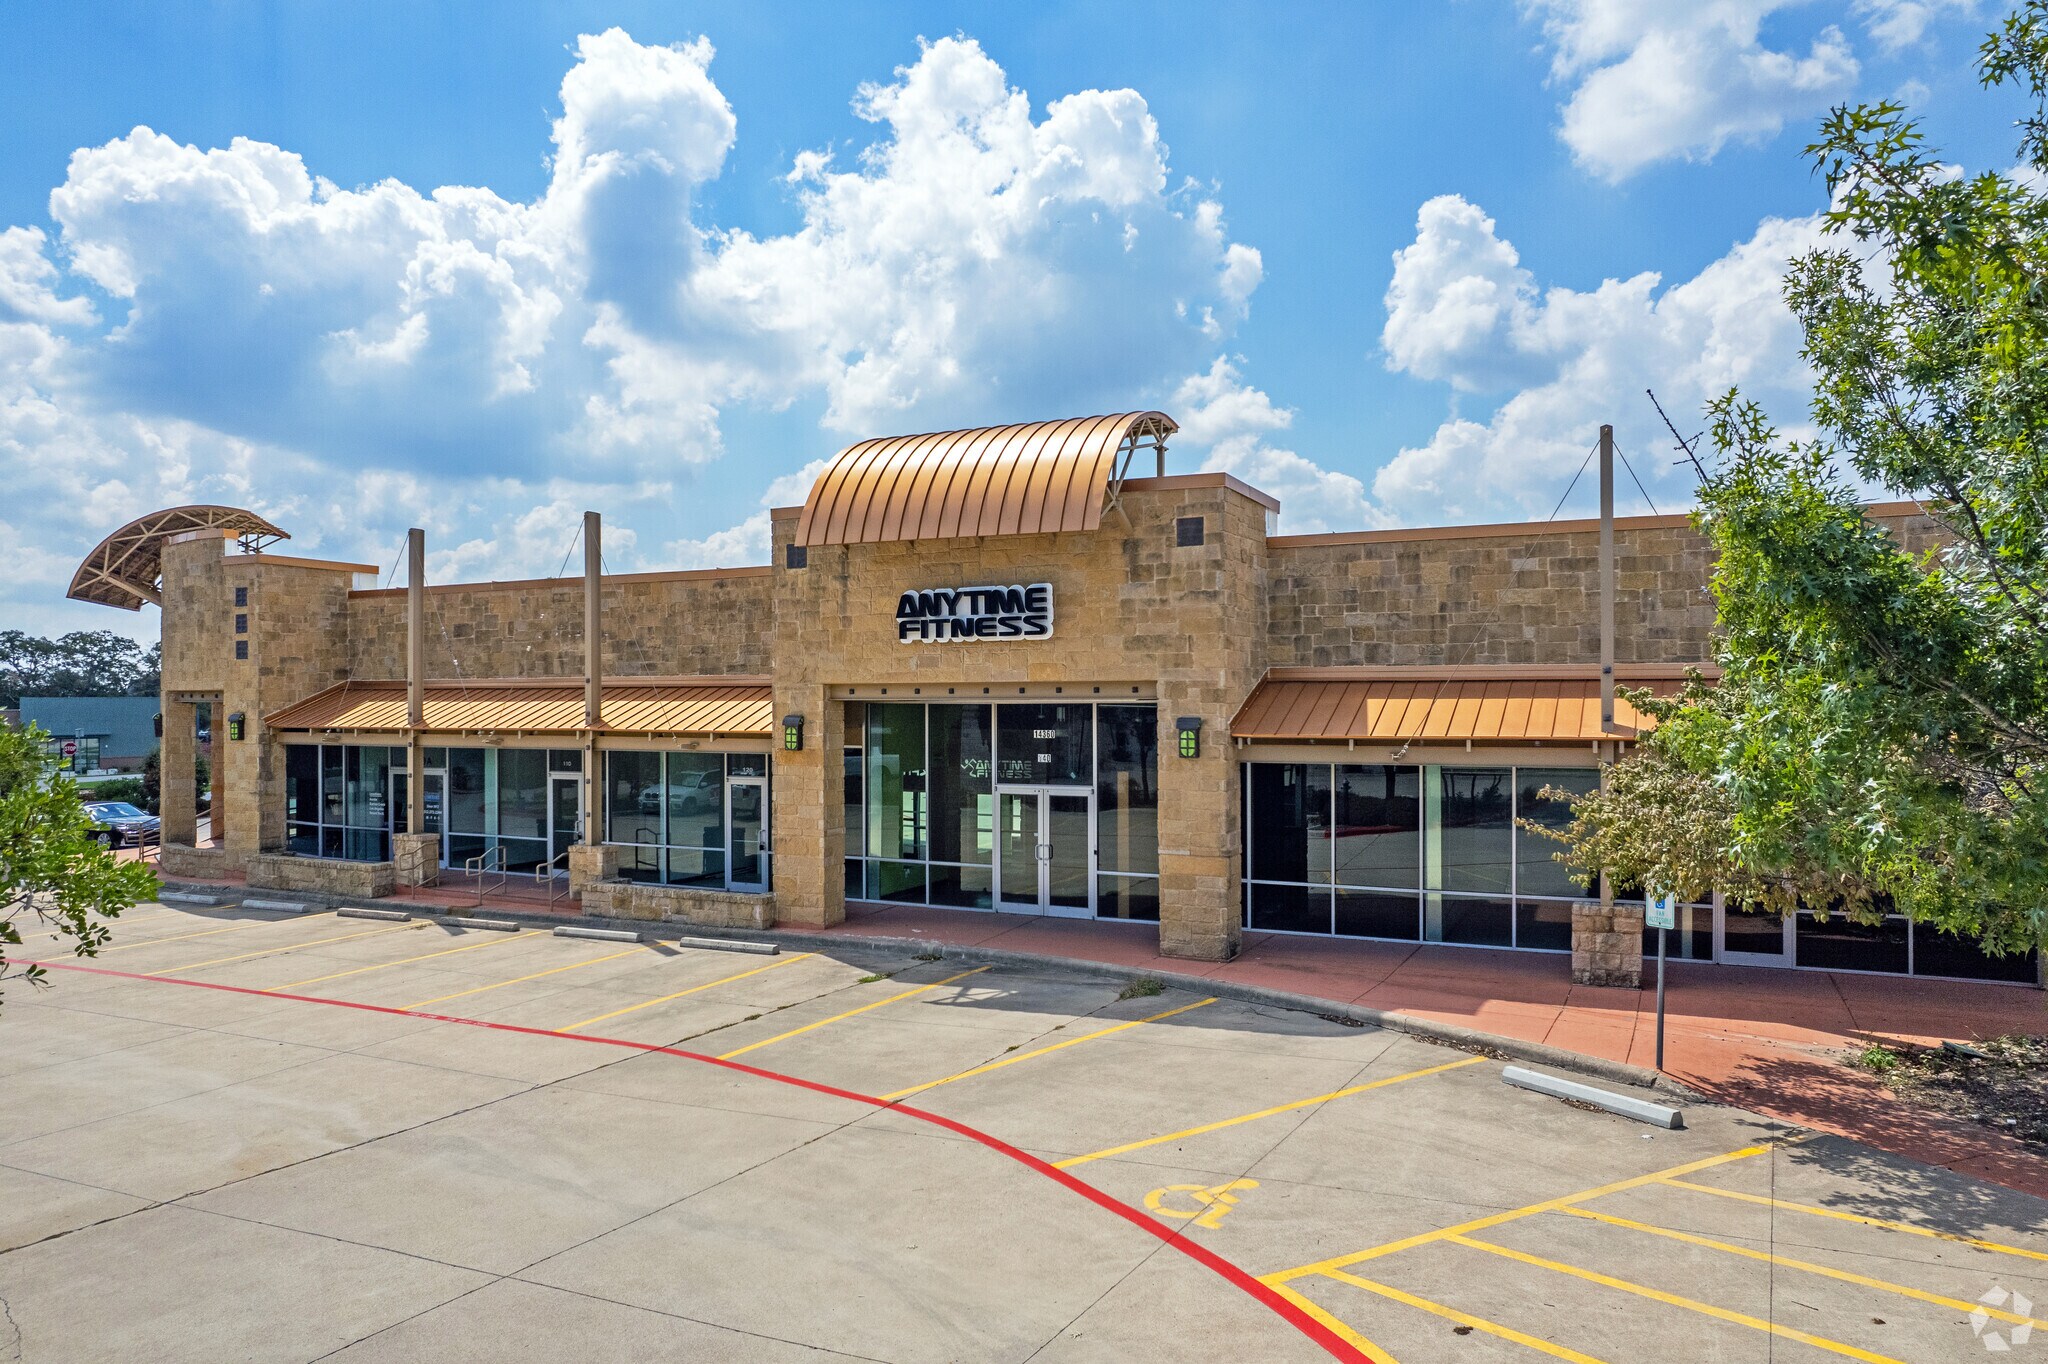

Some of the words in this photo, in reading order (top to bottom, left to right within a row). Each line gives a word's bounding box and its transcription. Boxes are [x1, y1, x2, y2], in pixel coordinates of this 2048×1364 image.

[896, 587, 1047, 618] ANYTIME
[898, 615, 1047, 640] FITNESS
[1034, 730, 1055, 738] 14360
[976, 760, 1032, 770] ANTIME
[976, 769, 1032, 778] FINESS
